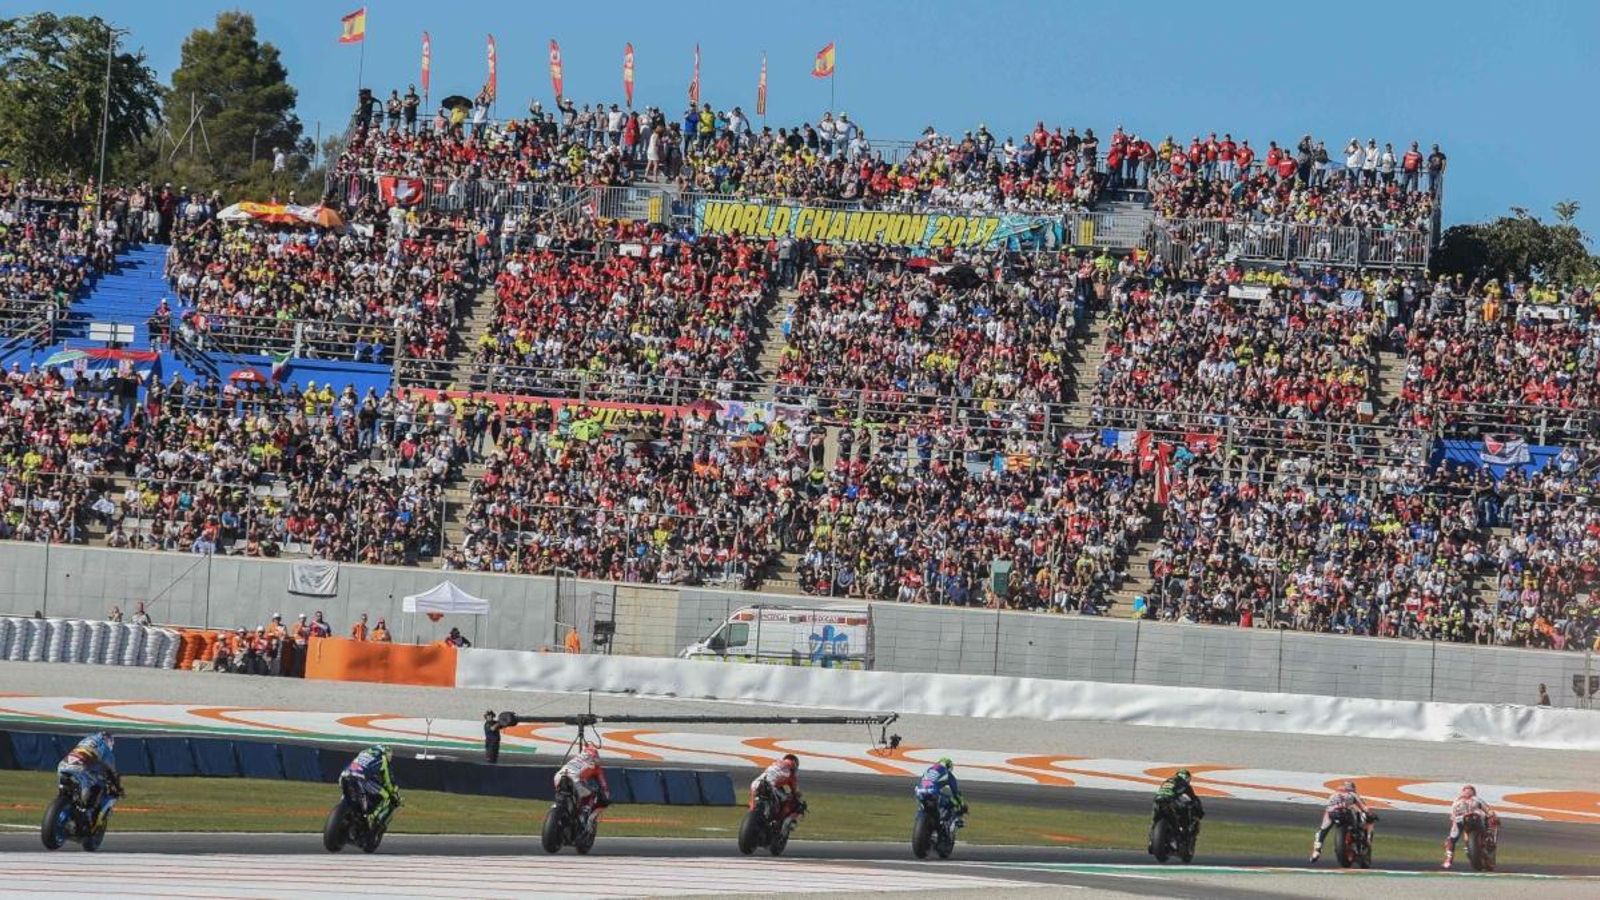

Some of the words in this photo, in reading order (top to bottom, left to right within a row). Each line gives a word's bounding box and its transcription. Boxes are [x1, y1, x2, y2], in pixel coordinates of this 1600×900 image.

[703, 202, 790, 237] WORLD
[796, 207, 928, 245] CHAMPION
[930, 214, 999, 247] 2017
